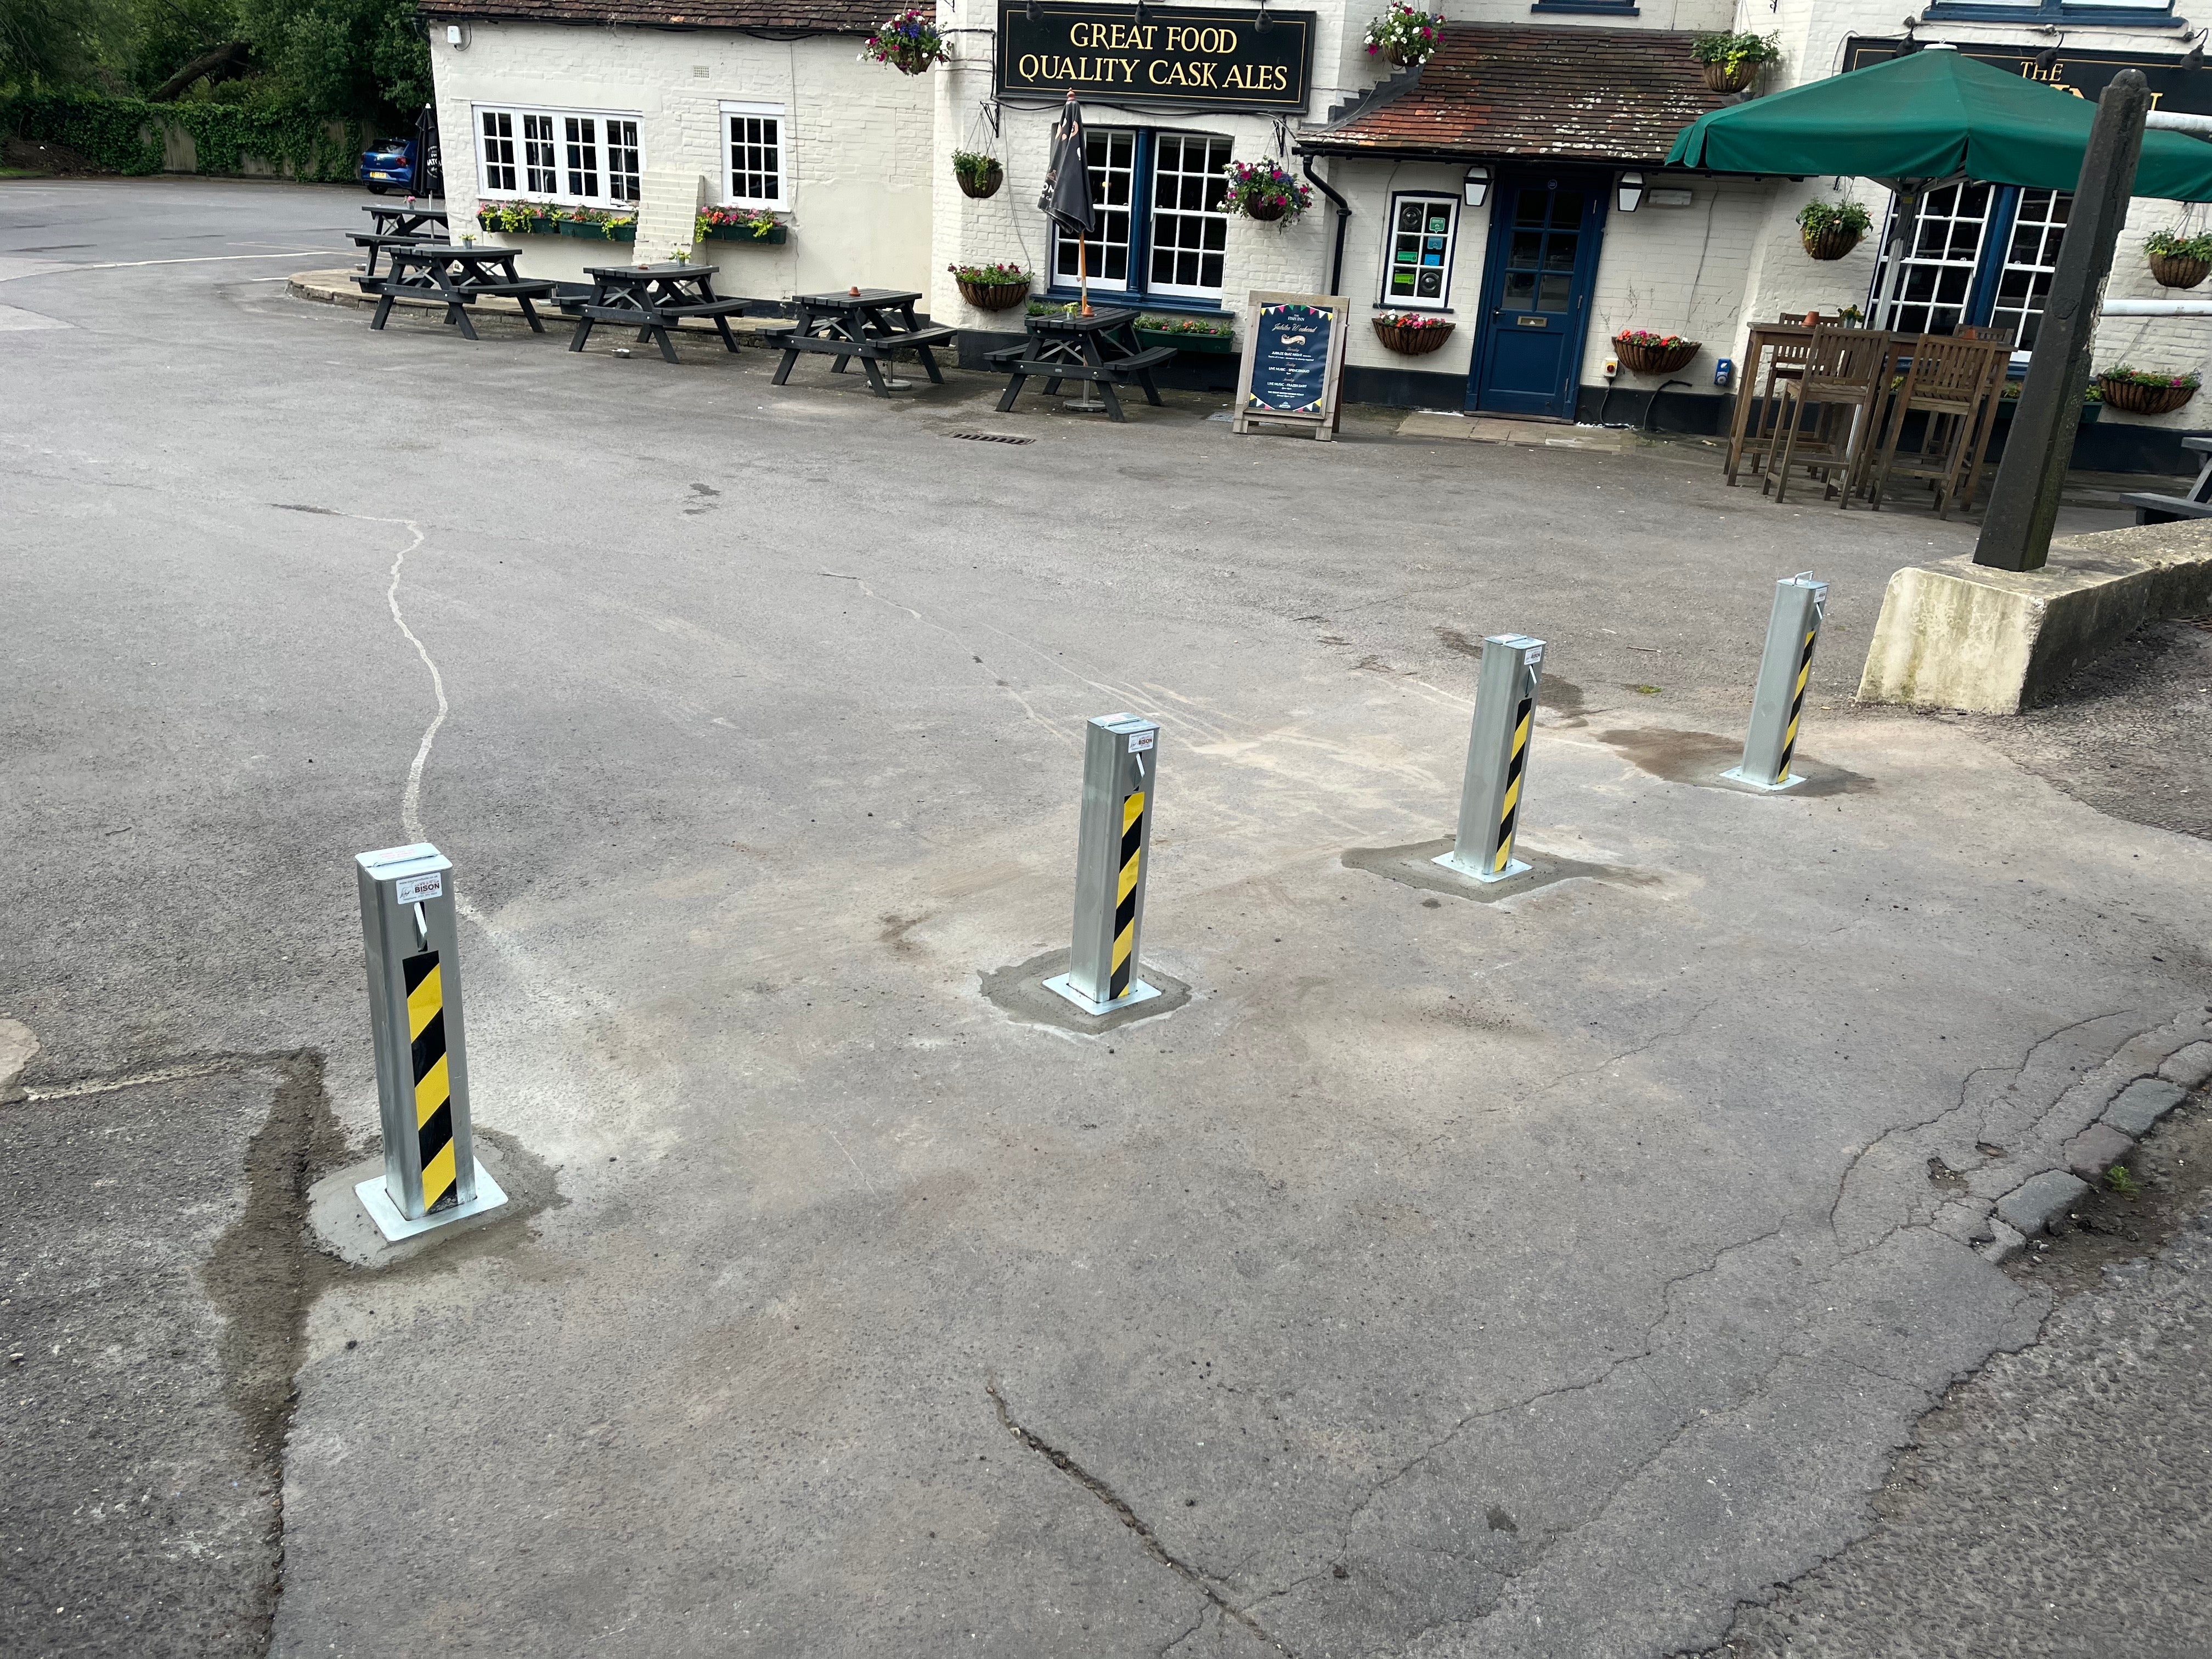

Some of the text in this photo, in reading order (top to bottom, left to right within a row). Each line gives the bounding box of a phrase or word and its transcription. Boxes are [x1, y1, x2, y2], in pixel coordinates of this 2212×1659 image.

[1070, 22, 1237, 54] GREAT FOOD
[1019, 54, 1288, 91] QUALITY CASK ALES
[2020, 61, 2063, 82] THE
[1272, 323, 1318, 332] Jubilee Weekend
[415, 883, 439, 893] BISON
